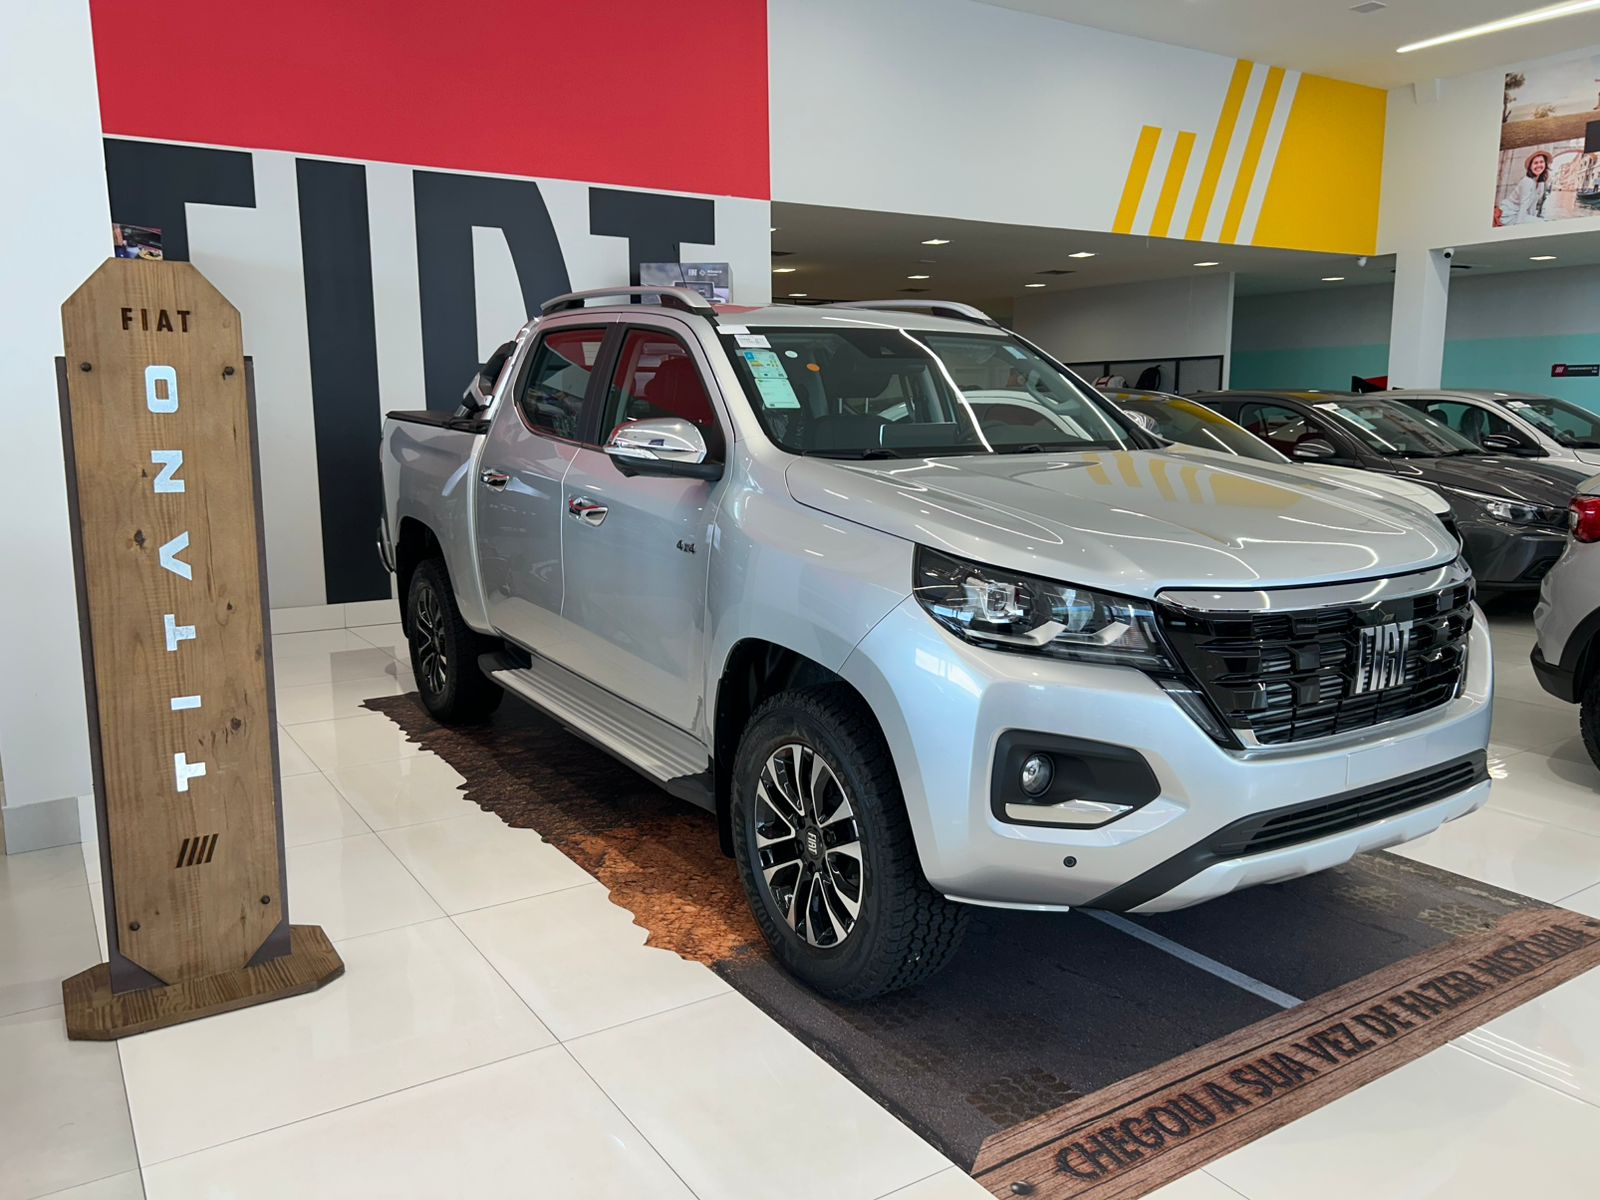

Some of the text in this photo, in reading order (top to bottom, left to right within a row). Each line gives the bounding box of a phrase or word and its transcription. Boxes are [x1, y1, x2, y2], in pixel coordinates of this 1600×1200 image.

[120, 307, 191, 333] FIAT
[144, 364, 206, 792] TITANO
[1355, 620, 1413, 694] FIAT
[807, 831, 818, 855] FIAT
[1055, 1093, 1217, 1182] CHEGOU
[1203, 1081, 1252, 1114] A
[1229, 1052, 1319, 1098] SUA
[1291, 1022, 1377, 1066] VEZ
[1351, 1004, 1416, 1039] DE
[1390, 971, 1495, 1020] FAZER
